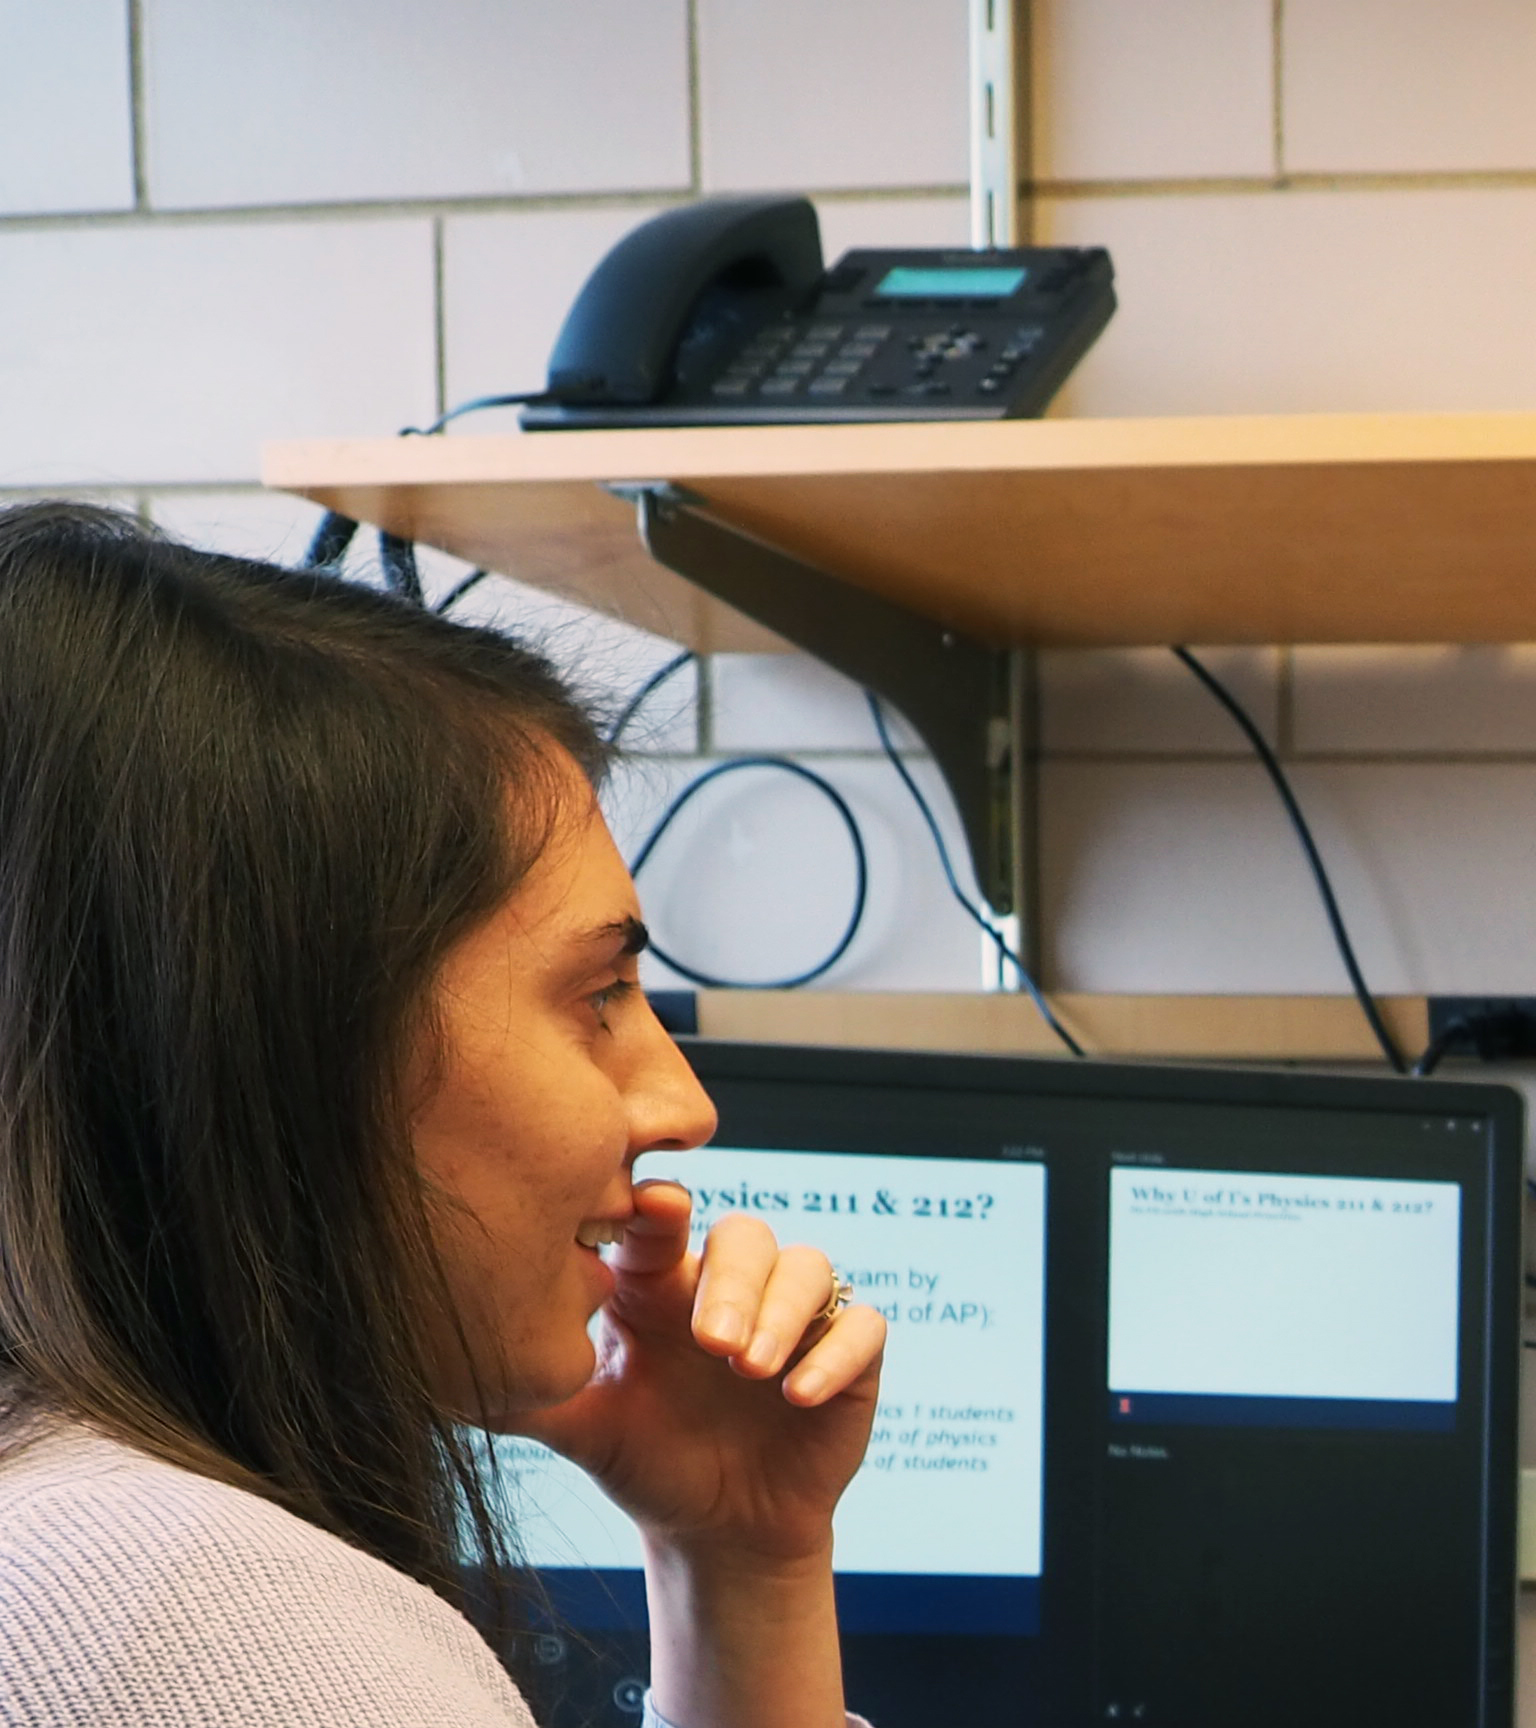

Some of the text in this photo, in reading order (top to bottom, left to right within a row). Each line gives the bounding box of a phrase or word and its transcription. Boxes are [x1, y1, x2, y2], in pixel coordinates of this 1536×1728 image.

[674, 1179, 994, 1220] ysics 211 & 212?
[1257, 1191, 1331, 1214] Physics
[908, 1266, 939, 1297] by
[908, 1302, 933, 1323] of
[930, 1405, 1014, 1423] students
[926, 1429, 998, 1447] physics
[904, 1455, 988, 1472] students
